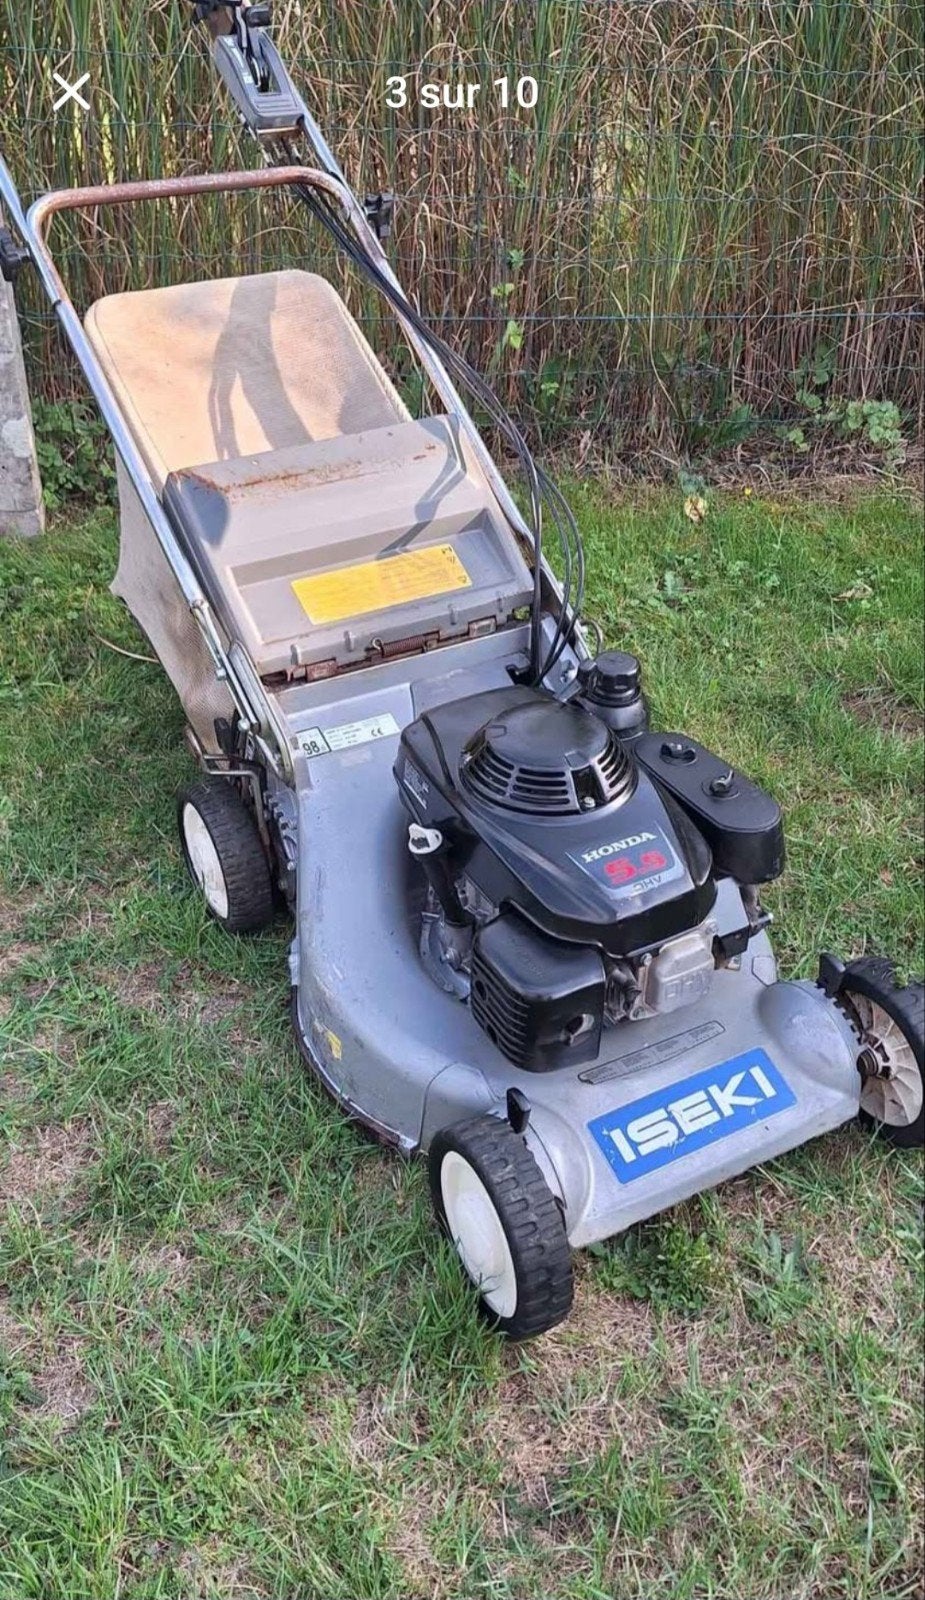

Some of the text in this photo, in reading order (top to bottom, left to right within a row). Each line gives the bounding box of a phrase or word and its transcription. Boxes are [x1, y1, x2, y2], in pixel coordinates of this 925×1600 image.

[302, 740, 320, 755] 98
[581, 832, 657, 863] HONDA
[609, 1065, 777, 1163] ISEKI
